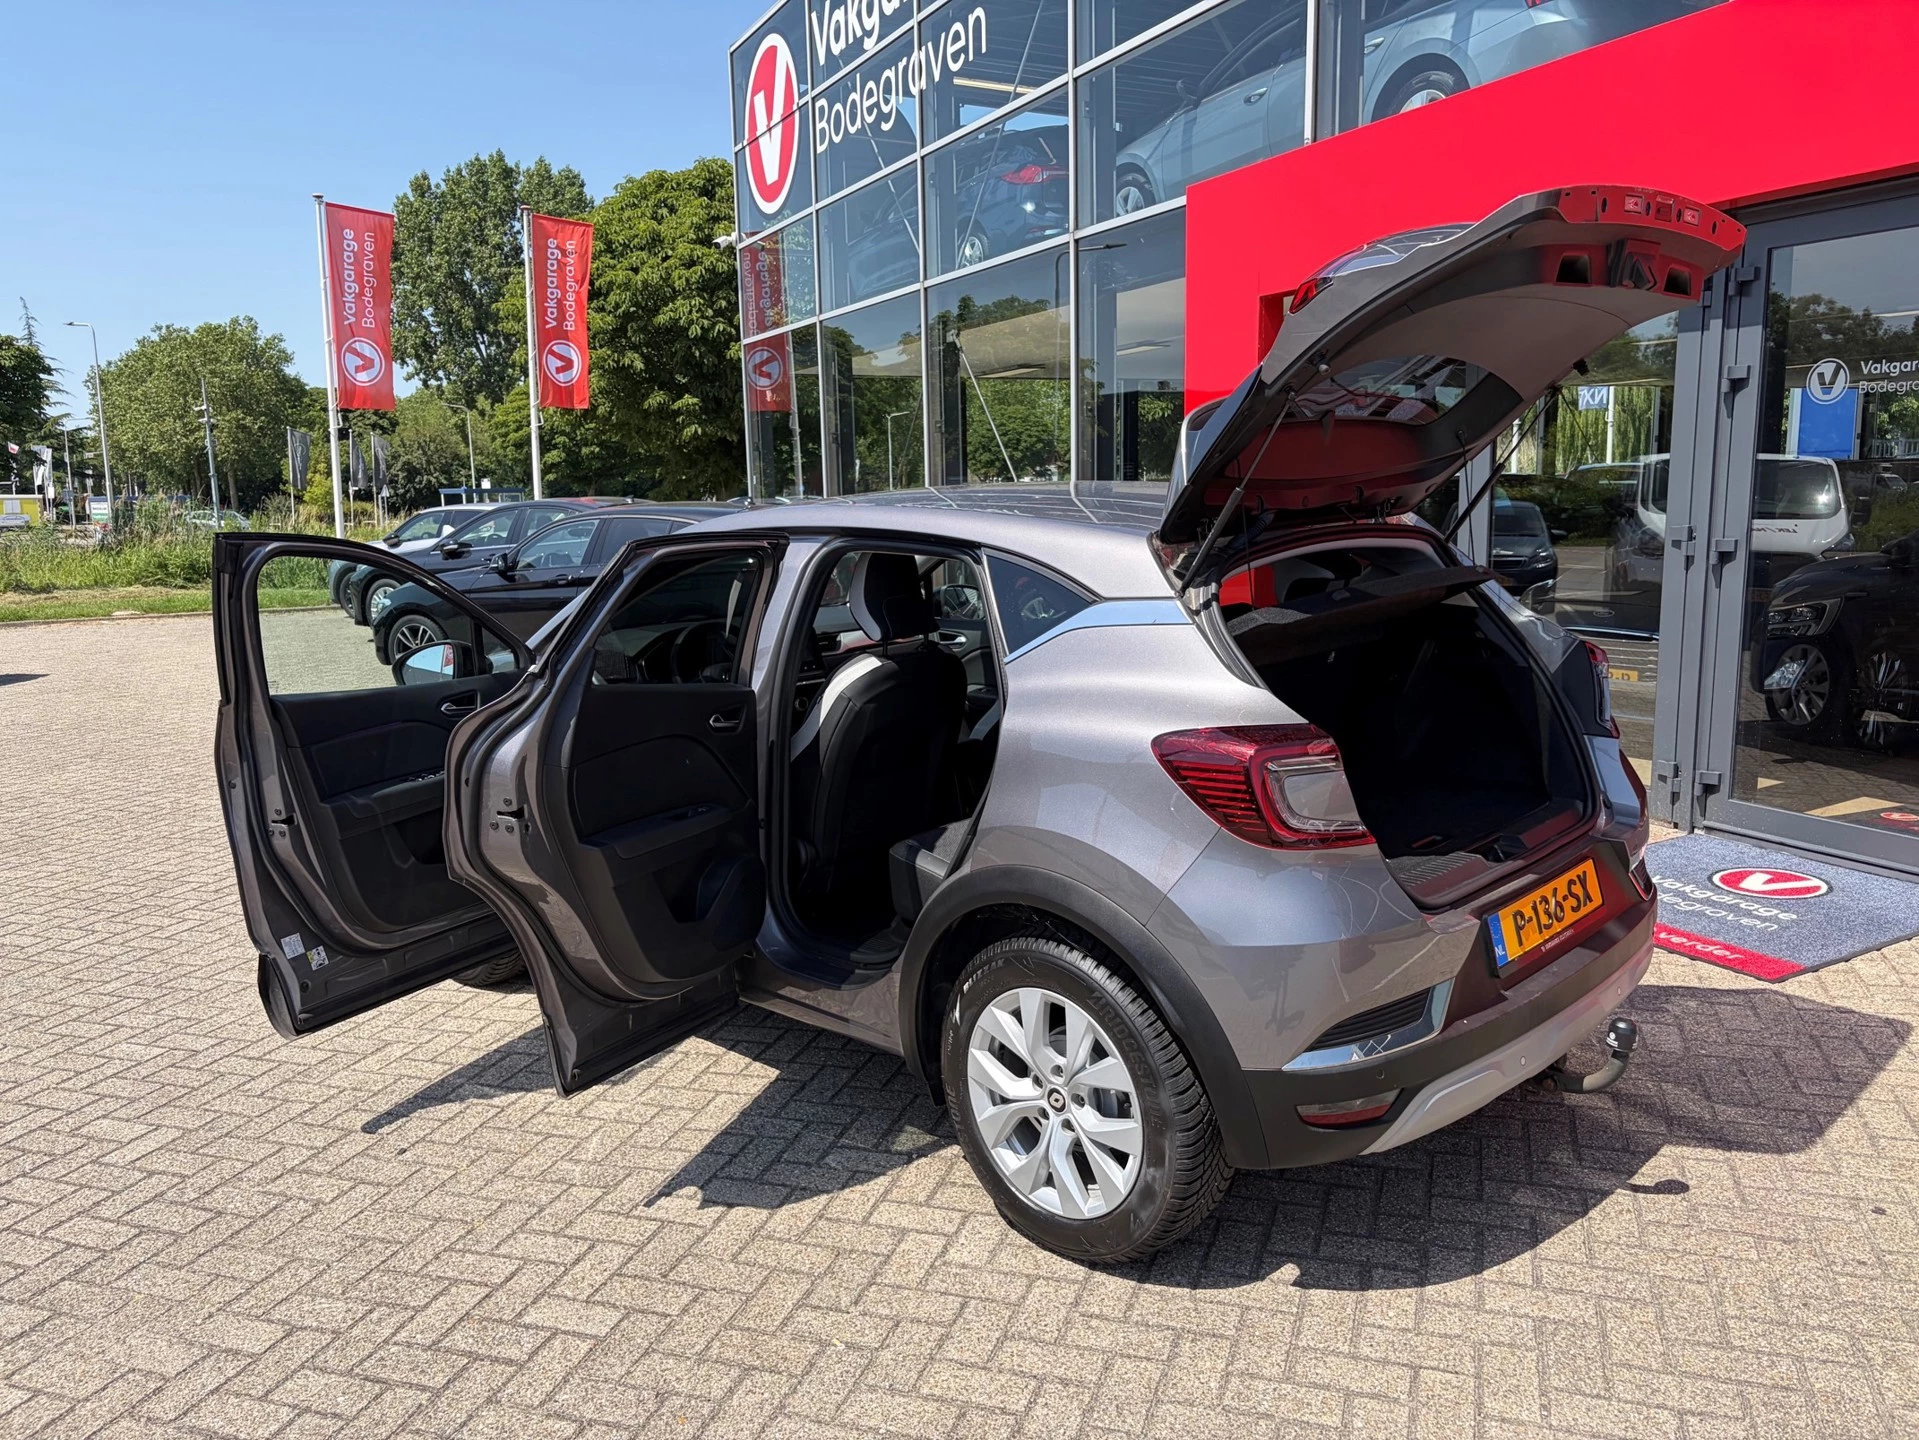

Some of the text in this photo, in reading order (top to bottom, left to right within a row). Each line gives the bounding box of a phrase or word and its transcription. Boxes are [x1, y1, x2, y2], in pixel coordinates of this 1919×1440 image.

[815, 6, 987, 155] Bodegraven
[343, 228, 359, 325] Vakgarage
[361, 231, 376, 329] Bodegraven
[544, 237, 561, 329] Vakgarage
[563, 239, 578, 331] Bodegraven
[1511, 870, 1594, 947] P-136-SX
[1652, 875, 1798, 921] Vakgarage
[1495, 944, 1506, 958] NL
[1659, 932, 1746, 960] verder
